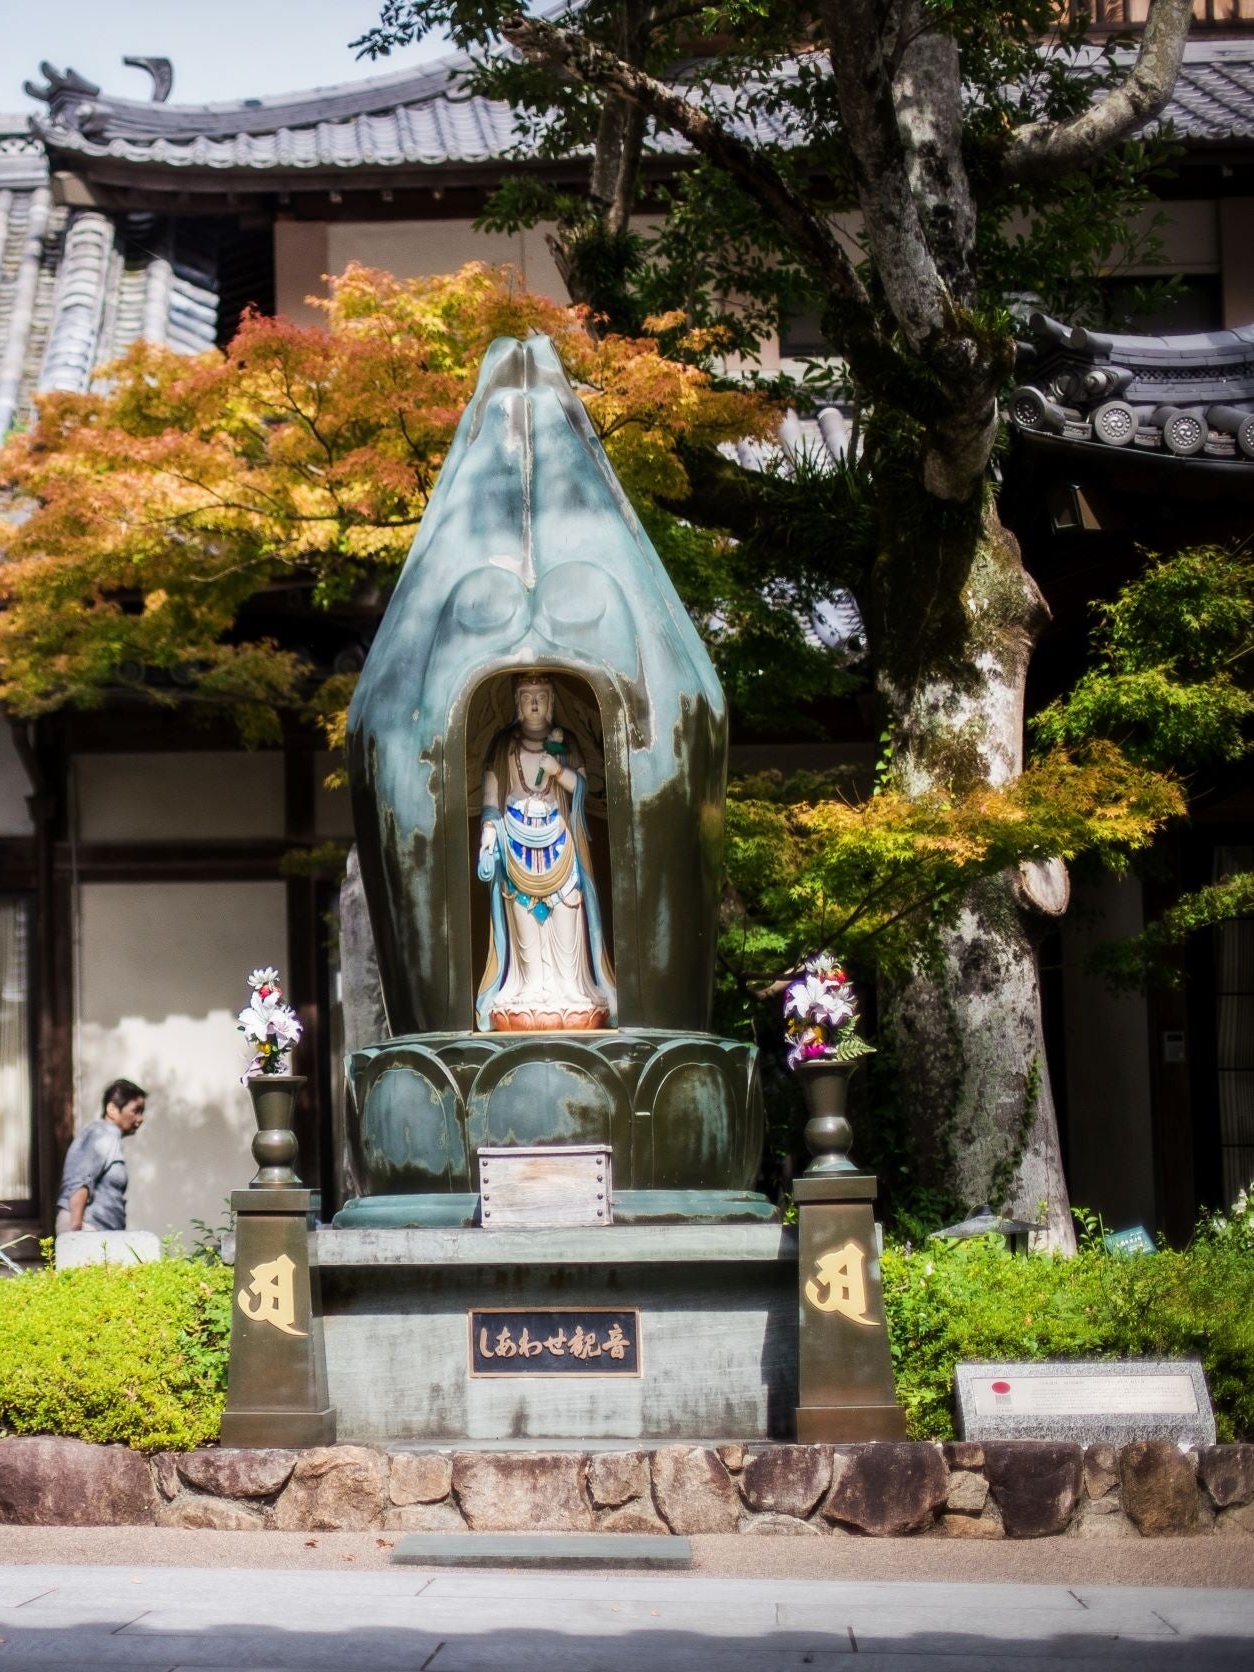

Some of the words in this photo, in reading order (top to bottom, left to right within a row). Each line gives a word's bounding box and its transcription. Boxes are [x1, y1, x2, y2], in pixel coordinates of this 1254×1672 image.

[479, 1323, 631, 1360] しあわせ観音
